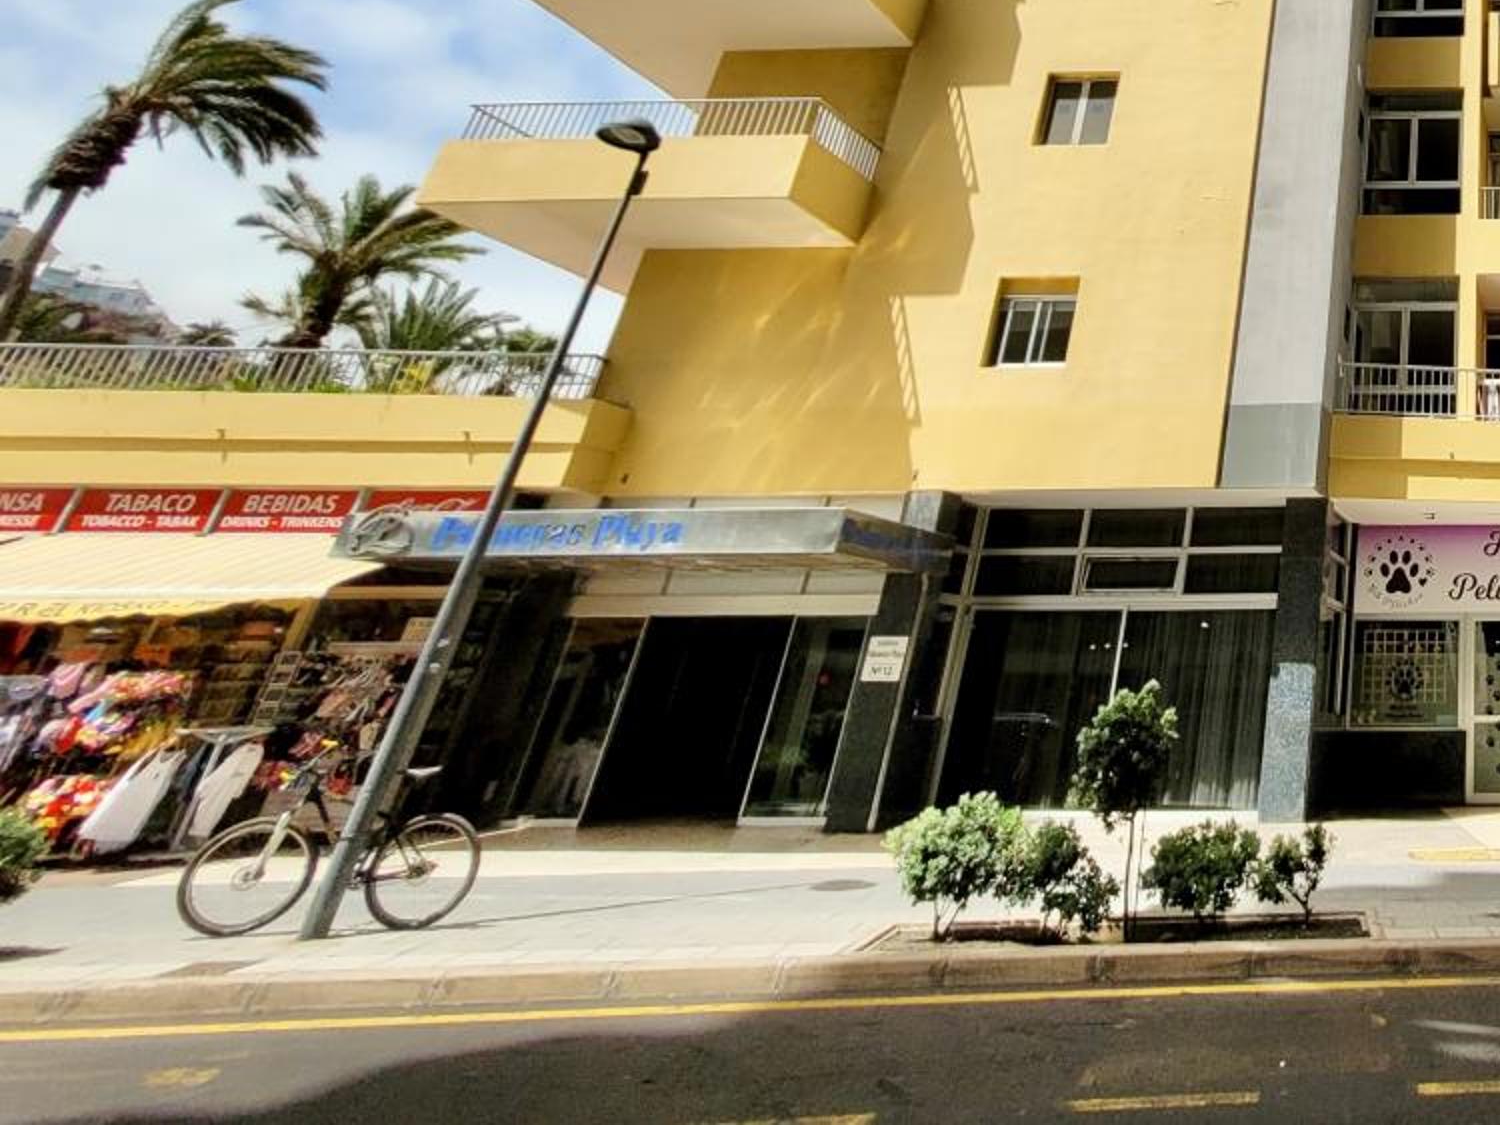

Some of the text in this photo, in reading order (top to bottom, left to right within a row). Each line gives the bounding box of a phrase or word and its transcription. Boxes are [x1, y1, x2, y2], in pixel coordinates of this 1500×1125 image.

[105, 494, 196, 512] TABACO
[243, 495, 340, 513] BEBIDAS
[81, 516, 146, 527] TOBACCO
[155, 516, 199, 527] TABAK
[220, 516, 270, 527] DRINKS
[593, 514, 684, 551] Playa
